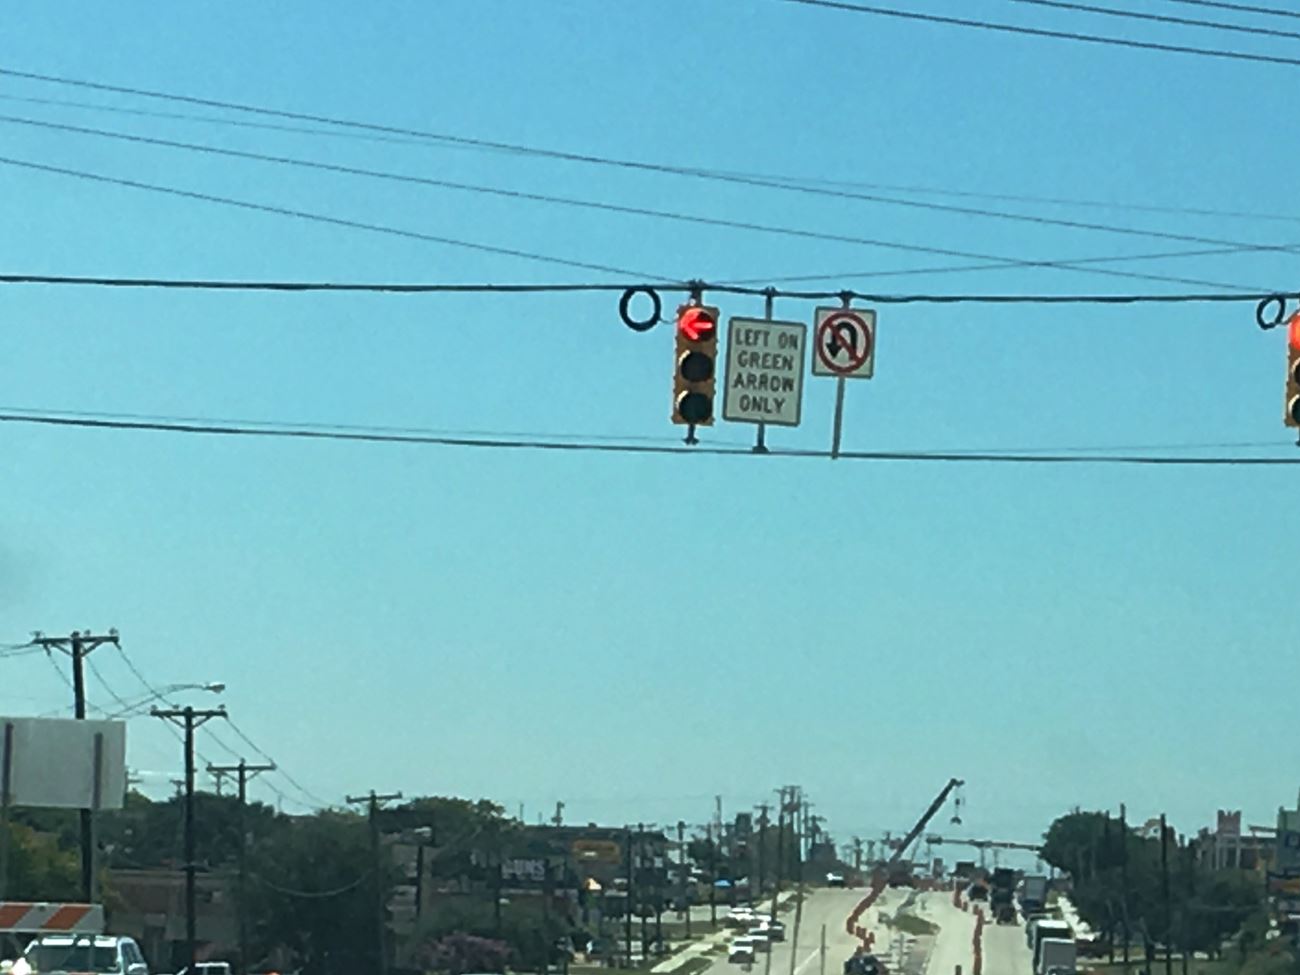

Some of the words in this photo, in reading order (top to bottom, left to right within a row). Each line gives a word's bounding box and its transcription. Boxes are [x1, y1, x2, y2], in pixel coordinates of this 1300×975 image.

[735, 327, 769, 347] LEFT
[778, 332, 798, 350] ON
[737, 351, 794, 371] GREEN
[732, 372, 794, 392] ARROW
[738, 394, 787, 414] ONLY
